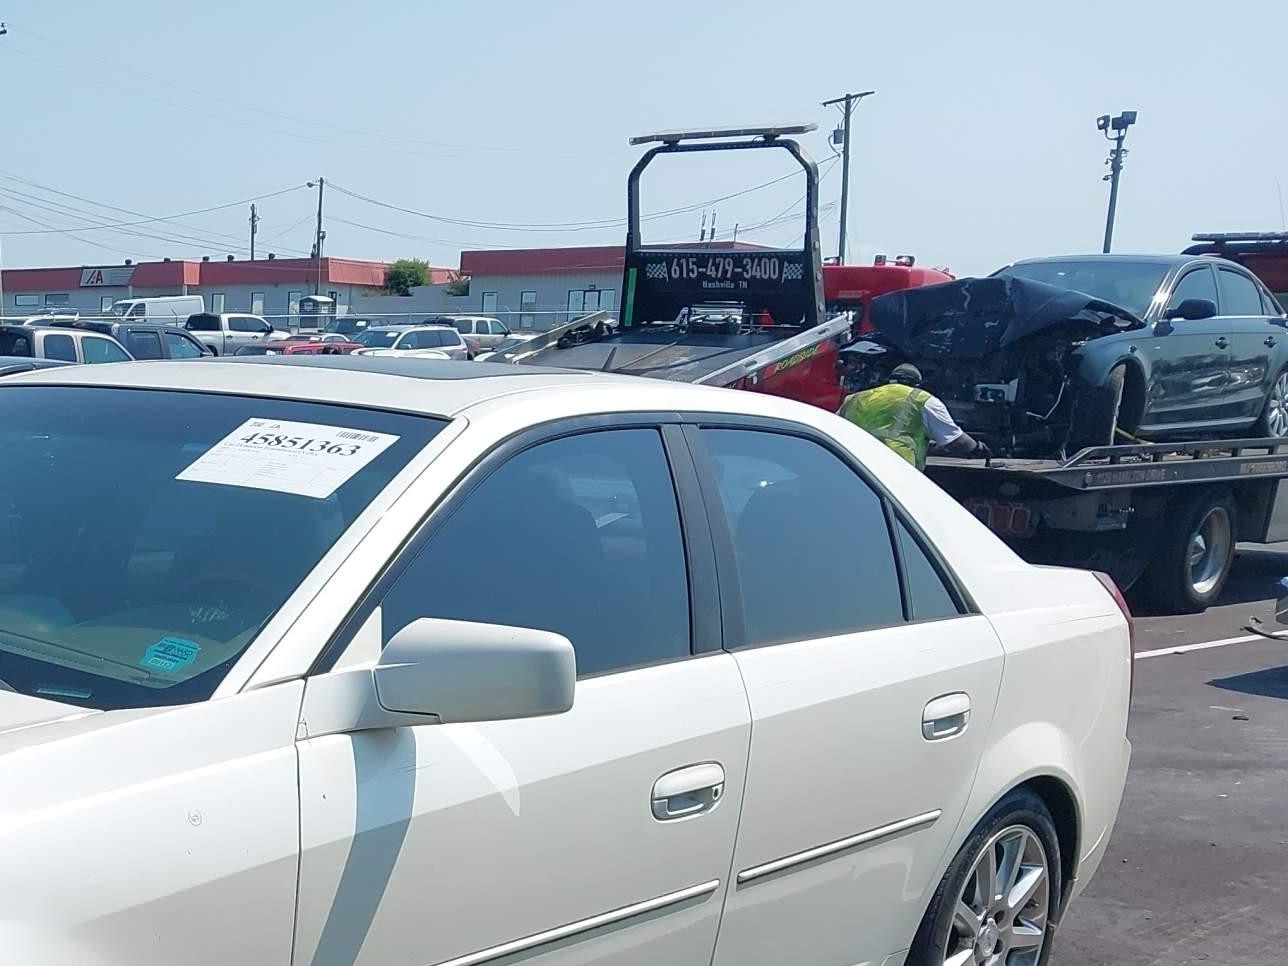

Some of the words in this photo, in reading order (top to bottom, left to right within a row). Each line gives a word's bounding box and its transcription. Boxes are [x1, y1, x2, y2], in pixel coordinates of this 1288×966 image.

[670, 258, 779, 279] 615-479-3400
[702, 280, 735, 289] Nashville
[738, 280, 748, 289] TN
[240, 432, 362, 457] 45851363
